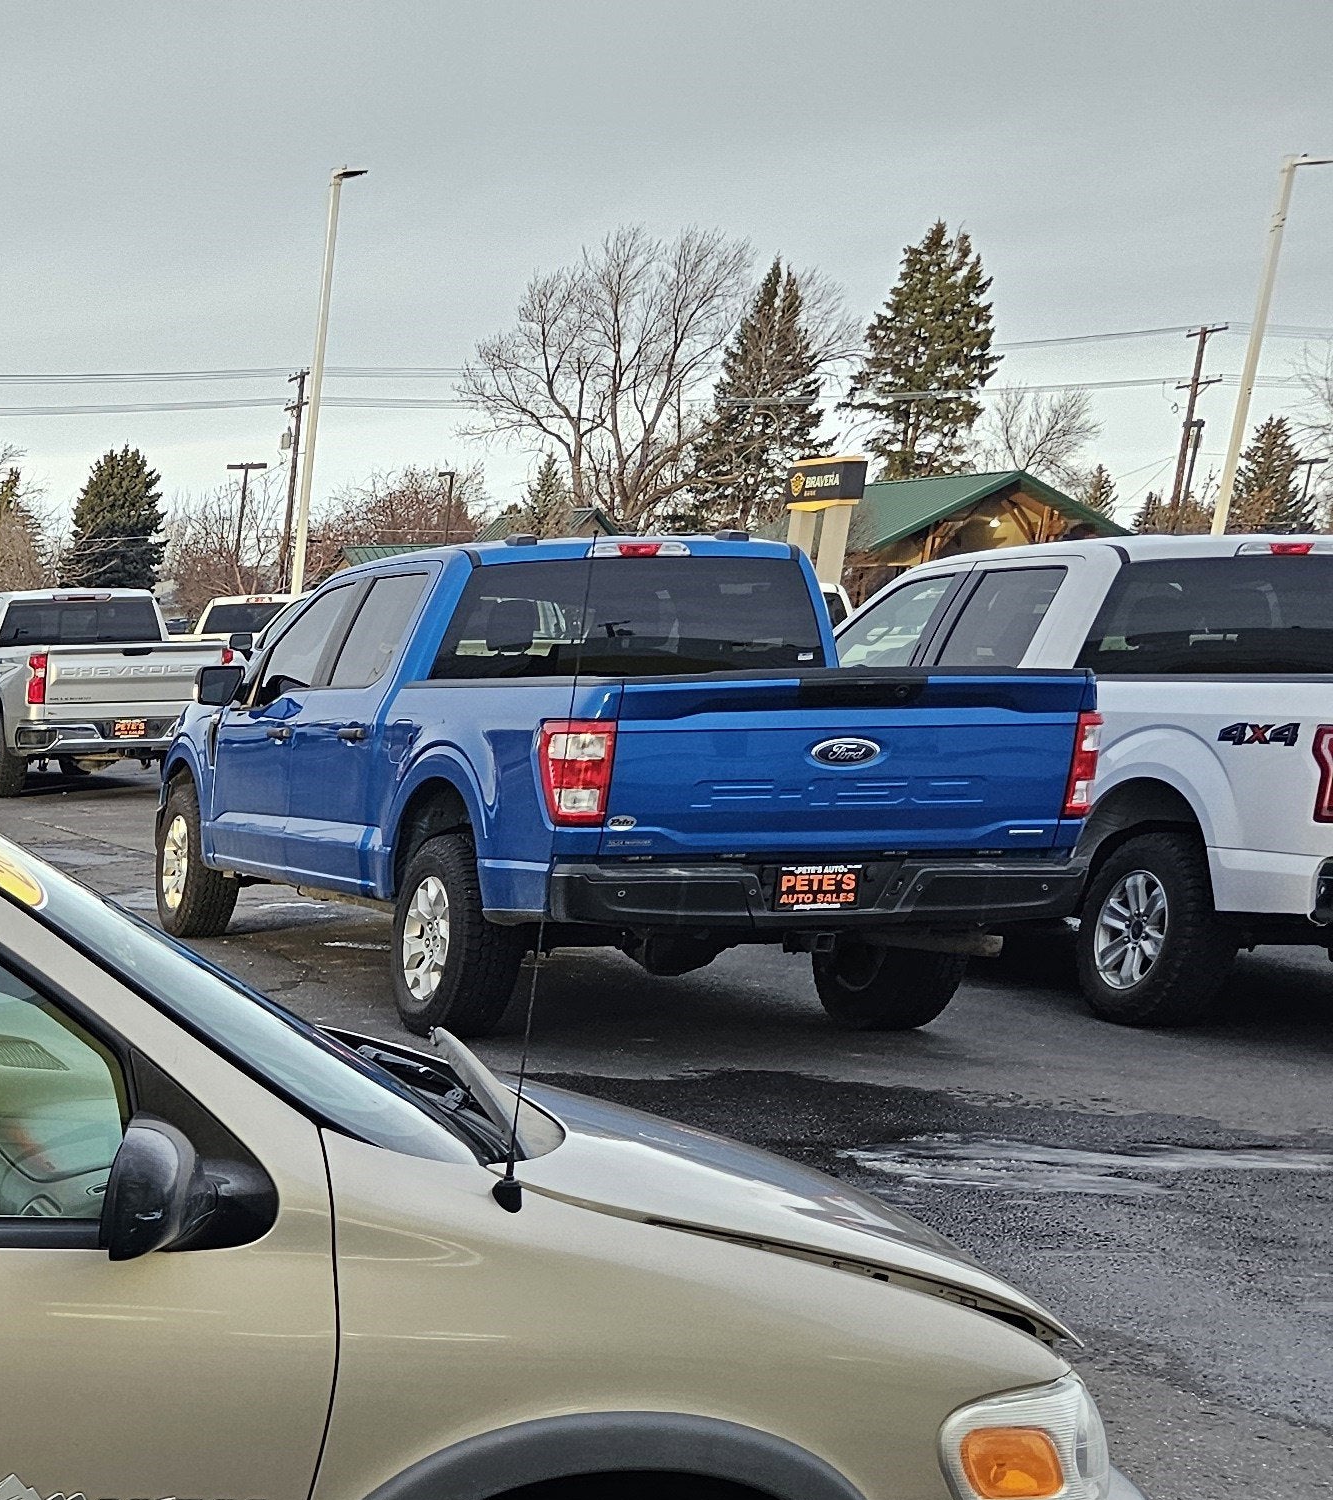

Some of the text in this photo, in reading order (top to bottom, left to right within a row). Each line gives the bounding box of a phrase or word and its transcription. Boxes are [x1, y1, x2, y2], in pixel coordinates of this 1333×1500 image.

[827, 743, 867, 762] Ford
[690, 775, 988, 808] F-150
[781, 873, 856, 891] PETE'S
[779, 892, 855, 903] AUTO SALES
